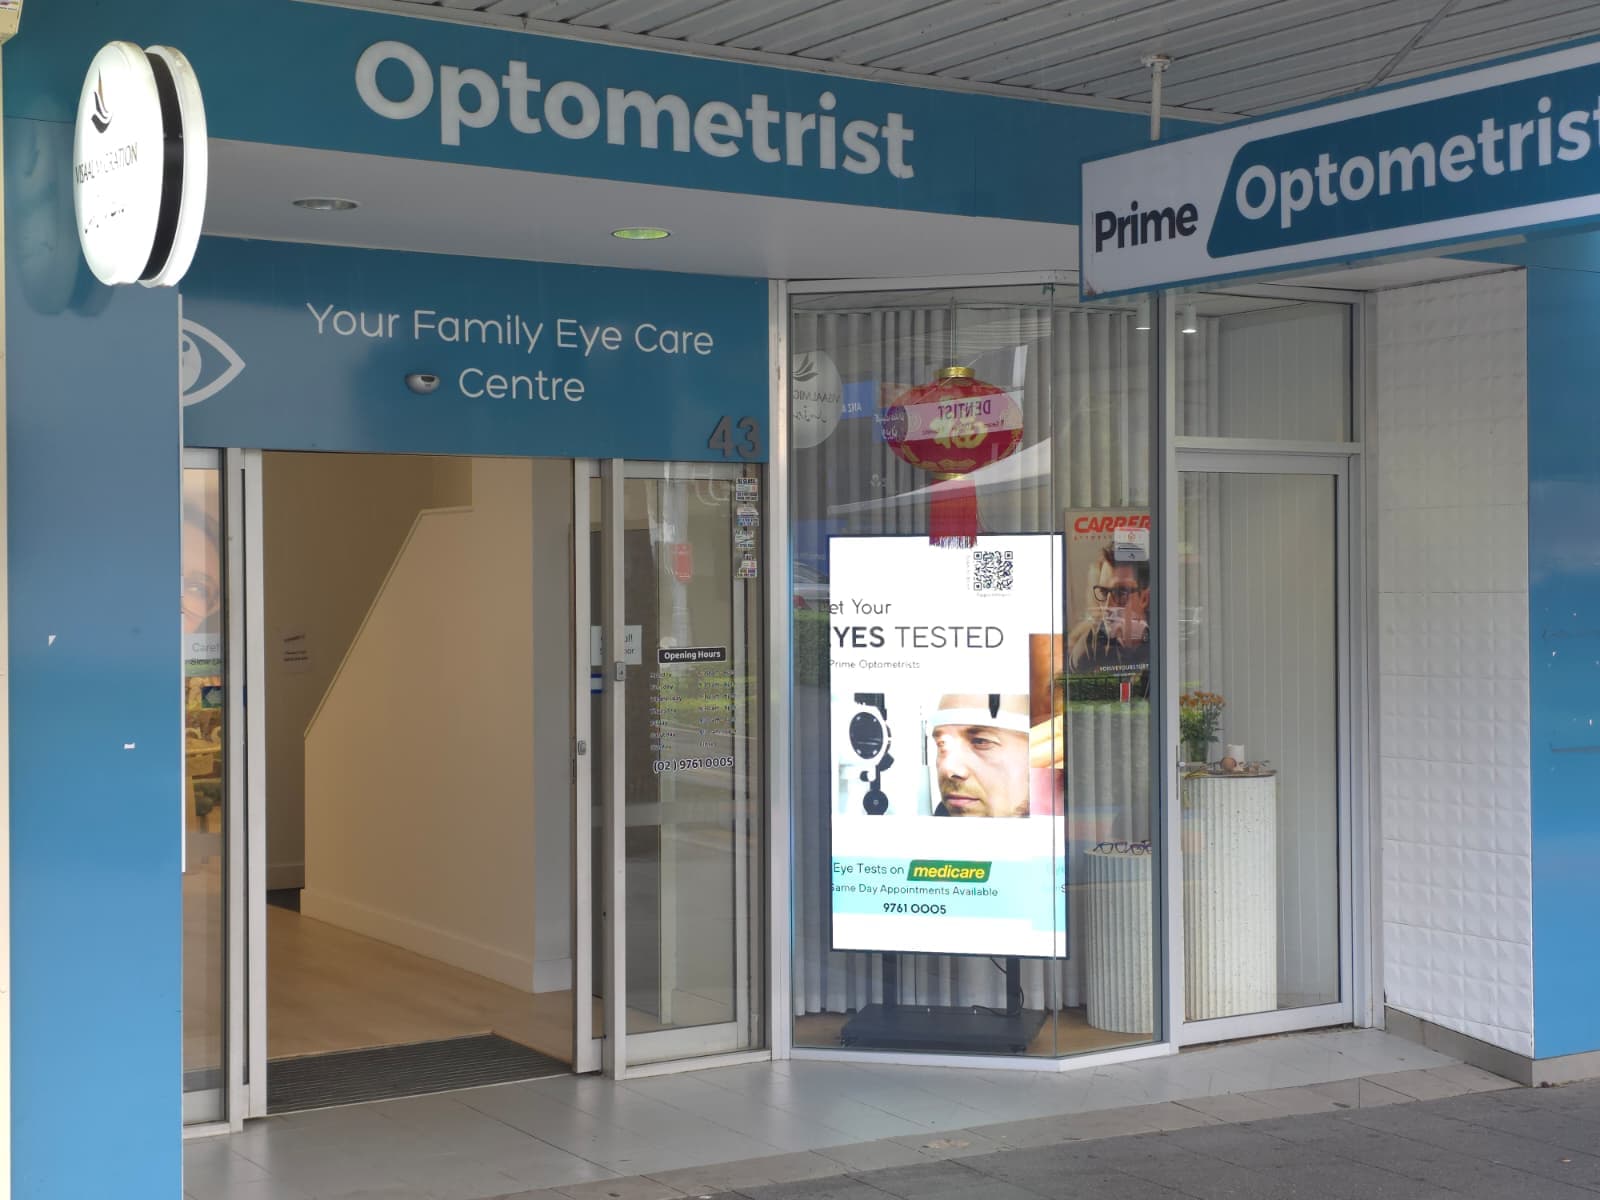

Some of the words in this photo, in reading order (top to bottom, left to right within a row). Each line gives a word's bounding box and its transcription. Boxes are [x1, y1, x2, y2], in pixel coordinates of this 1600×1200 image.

[355, 40, 915, 180] Optometrist
[1095, 200, 1199, 253] Prime
[1235, 95, 1600, 230] Optometris
[306, 302, 400, 339] Your
[413, 310, 544, 355] Family
[557, 319, 623, 357] Eye
[634, 323, 714, 355] Care
[458, 367, 585, 401] Centre
[707, 415, 762, 459] 43
[851, 598, 892, 615] Your
[829, 626, 886, 649] YES
[894, 626, 1004, 649] TESTED
[664, 651, 697, 660] Opening
[698, 650, 721, 659] Hours
[858, 659, 921, 670] Optometrists
[679, 758, 703, 770] 9761
[705, 756, 733, 768] 0005
[833, 863, 853, 875] Eye
[857, 863, 887, 874] Tests
[890, 866, 904, 875] on
[913, 865, 985, 879] medicare
[859, 883, 877, 895] Day
[880, 884, 950, 896] Appointments
[953, 885, 998, 897] Available
[883, 902, 908, 913] 9761
[910, 903, 947, 914] 0005
